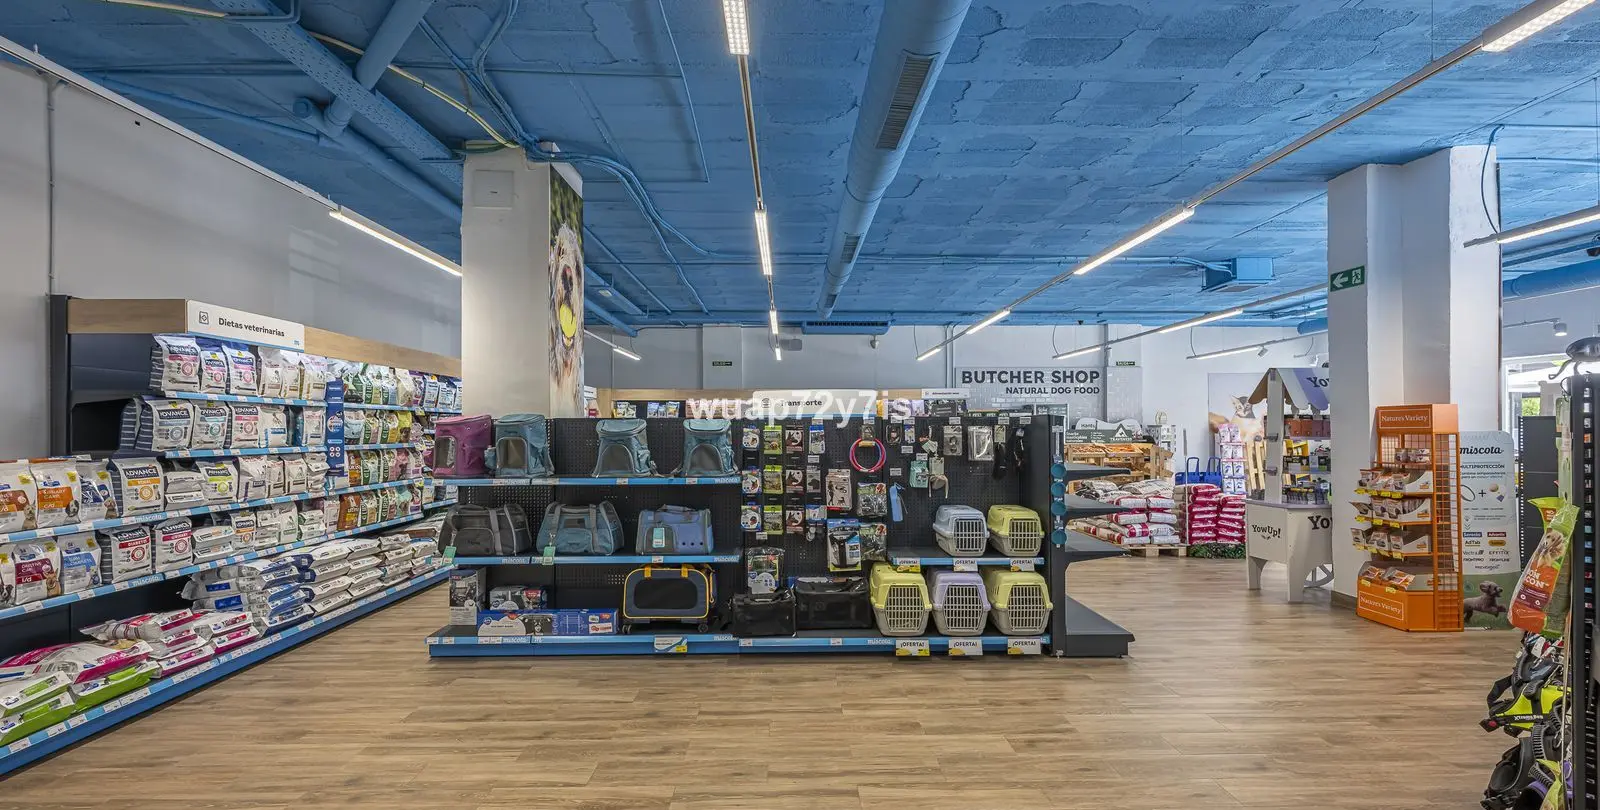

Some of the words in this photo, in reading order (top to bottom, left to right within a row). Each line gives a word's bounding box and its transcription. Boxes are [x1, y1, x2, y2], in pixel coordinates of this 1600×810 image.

[218, 317, 243, 329] Dietas
[244, 324, 285, 337] veterinarias
[961, 370, 1045, 384] BUTCHER
[1050, 370, 1100, 384] SHOP
[1005, 386, 1049, 395] NATURAL
[1051, 386, 1072, 395] DOG
[1074, 386, 1101, 395] FOOD
[1459, 446, 1504, 455] miscota
[125, 469, 157, 477] ADVANCE
[134, 513, 162, 523] miscota
[1307, 515, 1332, 530] Yo
[1251, 524, 1281, 539] YowUp!
[900, 640, 925, 648] ¡OFERTA!
[953, 640, 977, 648] ¡OFERTA!
[1012, 639, 1036, 647] ¡OFERTA!
